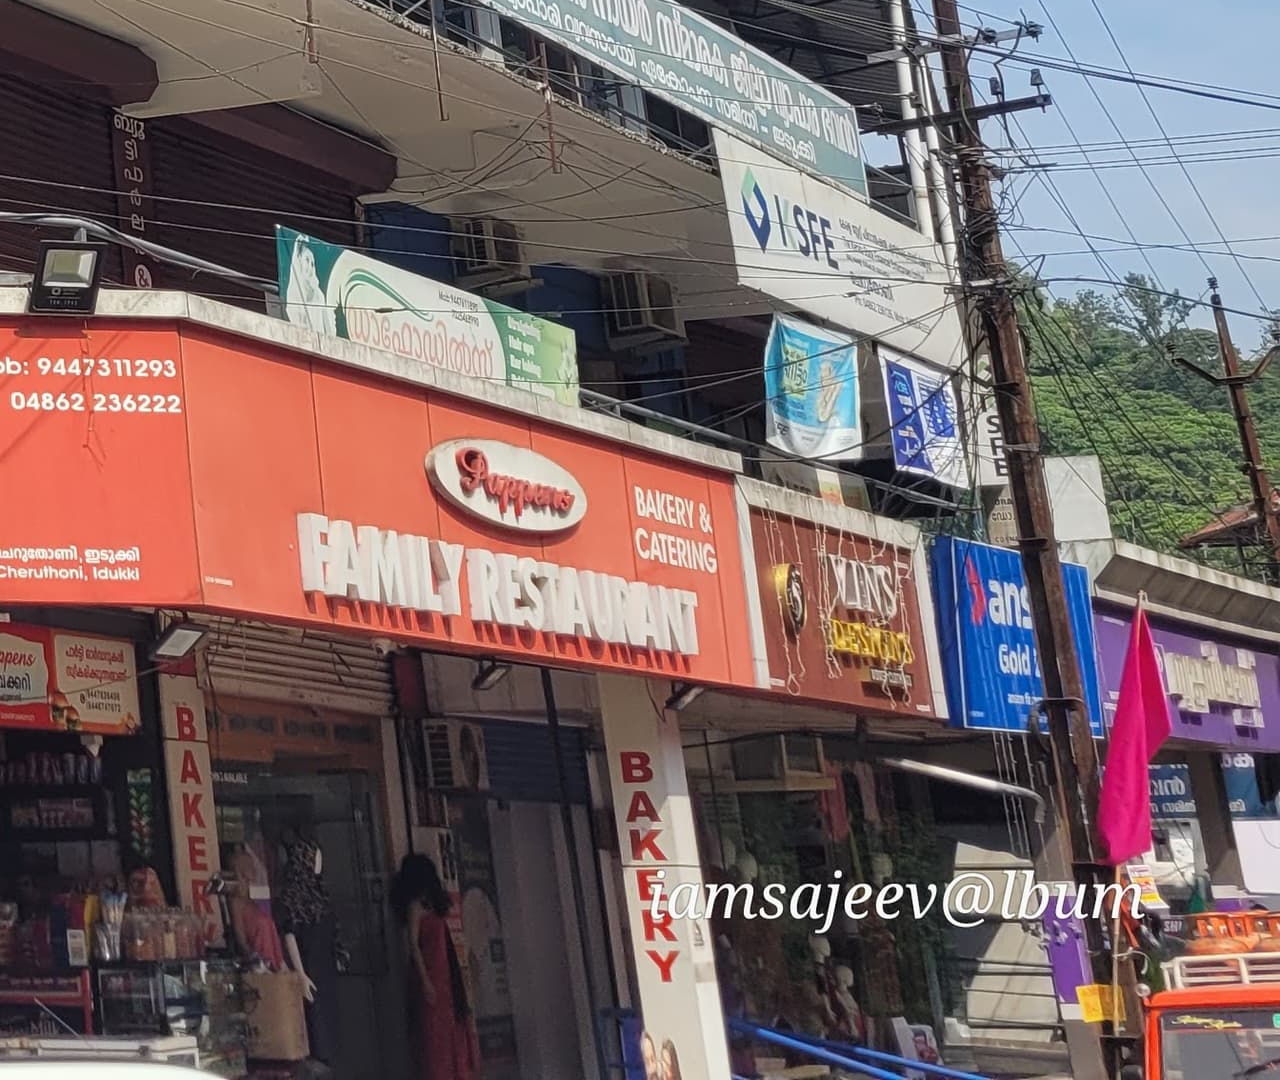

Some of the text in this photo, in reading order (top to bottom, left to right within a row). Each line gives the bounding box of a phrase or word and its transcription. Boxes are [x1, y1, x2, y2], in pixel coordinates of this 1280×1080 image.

[774, 194, 839, 271] KSFE
[37, 357, 177, 378] 9447311293
[11, 392, 182, 414] 04862 236222
[455, 446, 576, 522] Pappens
[634, 484, 713, 534] BAKERY &
[93, 566, 140, 581] Idukki
[634, 527, 718, 575] CATERING
[296, 512, 699, 656] FAMILY RESTAURANT
[998, 642, 1031, 676] Gold
[620, 751, 680, 983] BAKERY
